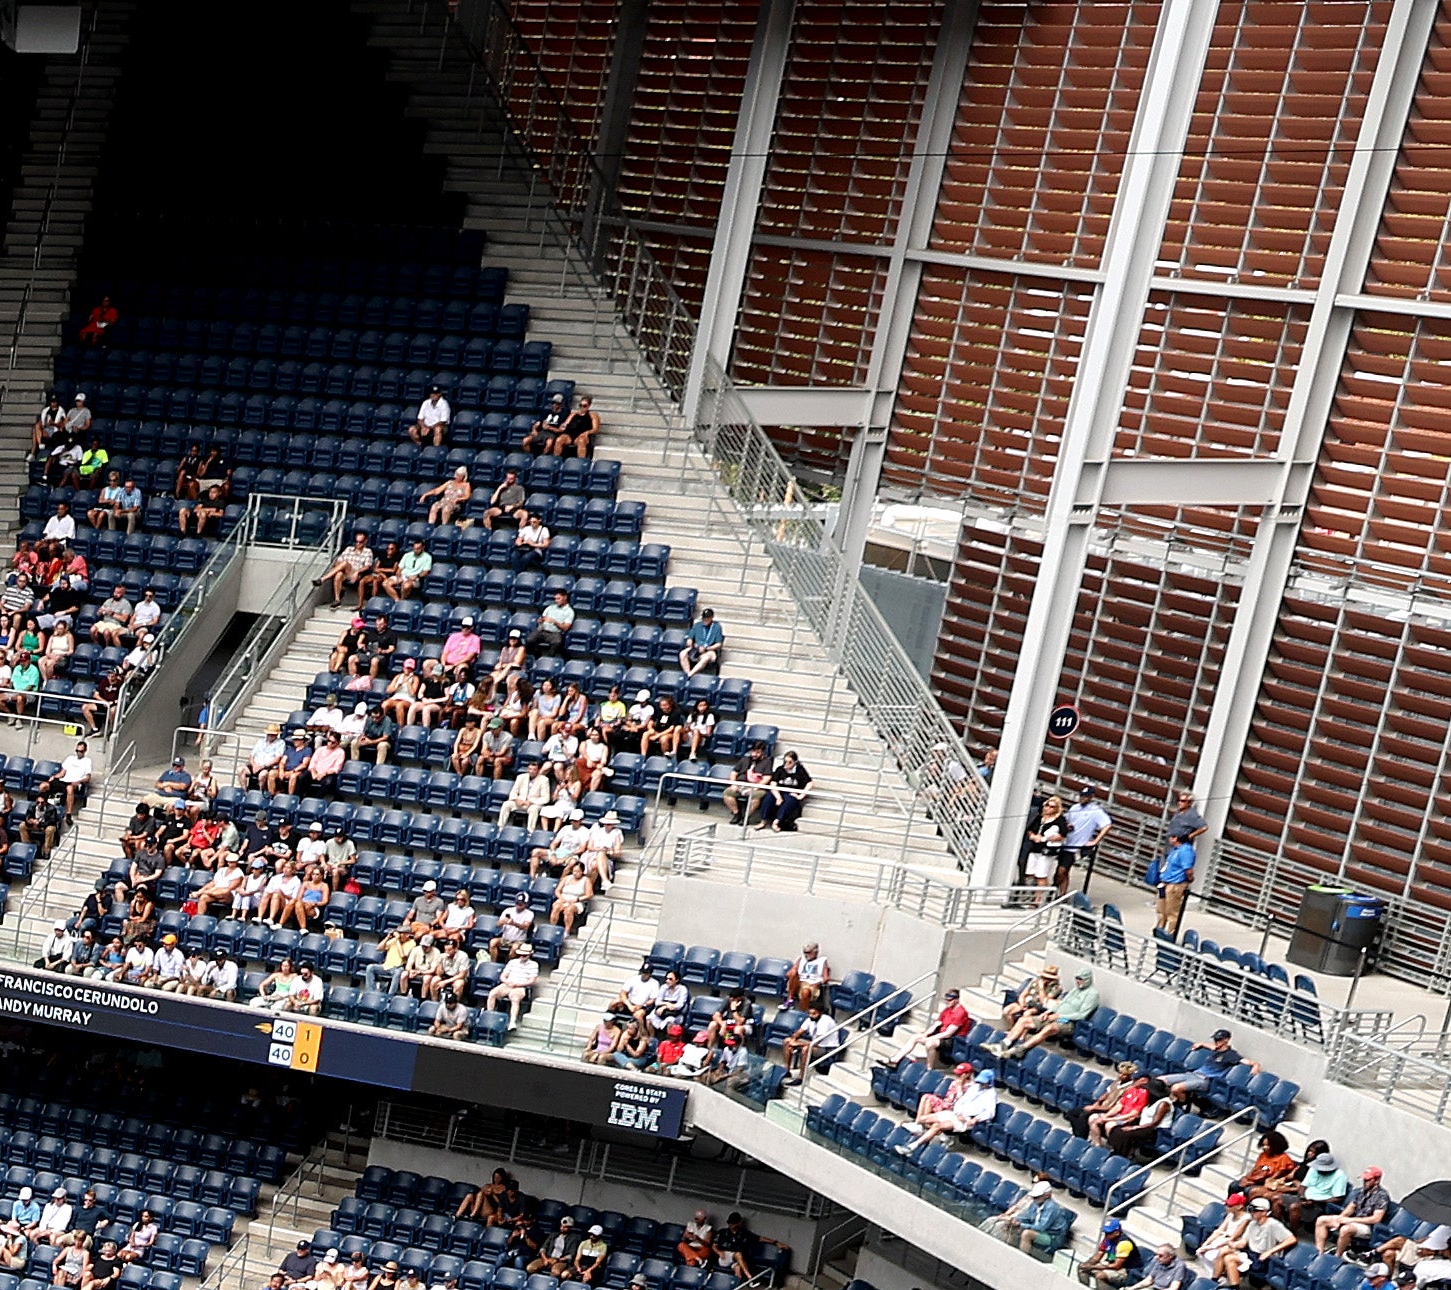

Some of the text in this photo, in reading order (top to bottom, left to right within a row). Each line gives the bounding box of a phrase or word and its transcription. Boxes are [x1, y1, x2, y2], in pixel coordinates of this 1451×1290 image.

[74, 987, 159, 1015] CERUNDOLO
[33, 1004, 92, 1026] MURRAY
[275, 1026, 294, 1038] 40
[272, 1048, 309, 1064] 40 0
[613, 1083, 638, 1093] CORES
[615, 1091, 661, 1105] POWERED BY
[607, 1101, 662, 1132] IBM
